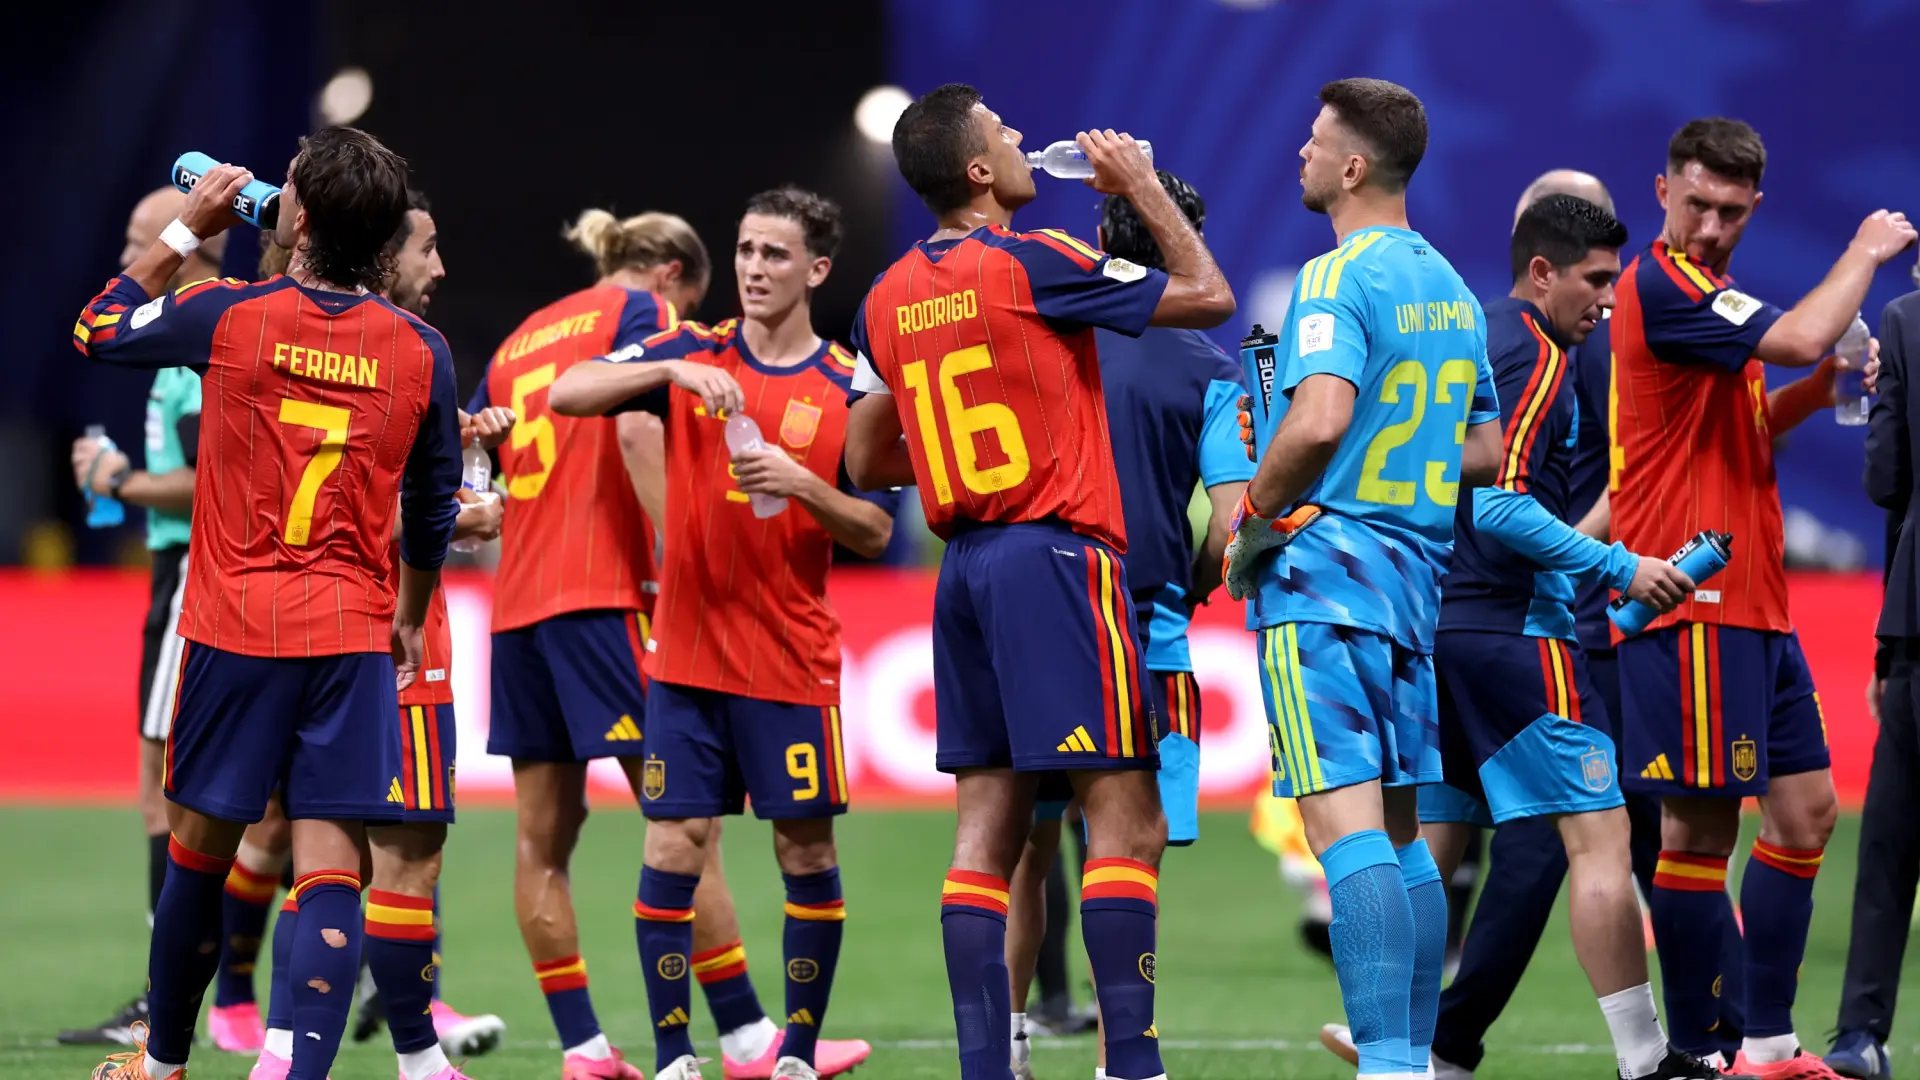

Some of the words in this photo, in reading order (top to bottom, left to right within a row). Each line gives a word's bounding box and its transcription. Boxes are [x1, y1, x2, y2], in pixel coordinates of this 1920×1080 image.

[273, 342, 378, 388] FERRAN
[896, 289, 978, 336] RODRIGO
[278, 398, 352, 547] 7
[508, 362, 557, 500] 5
[901, 343, 1031, 506] 16
[1356, 359, 1477, 507] 23
[785, 742, 819, 801] 9
